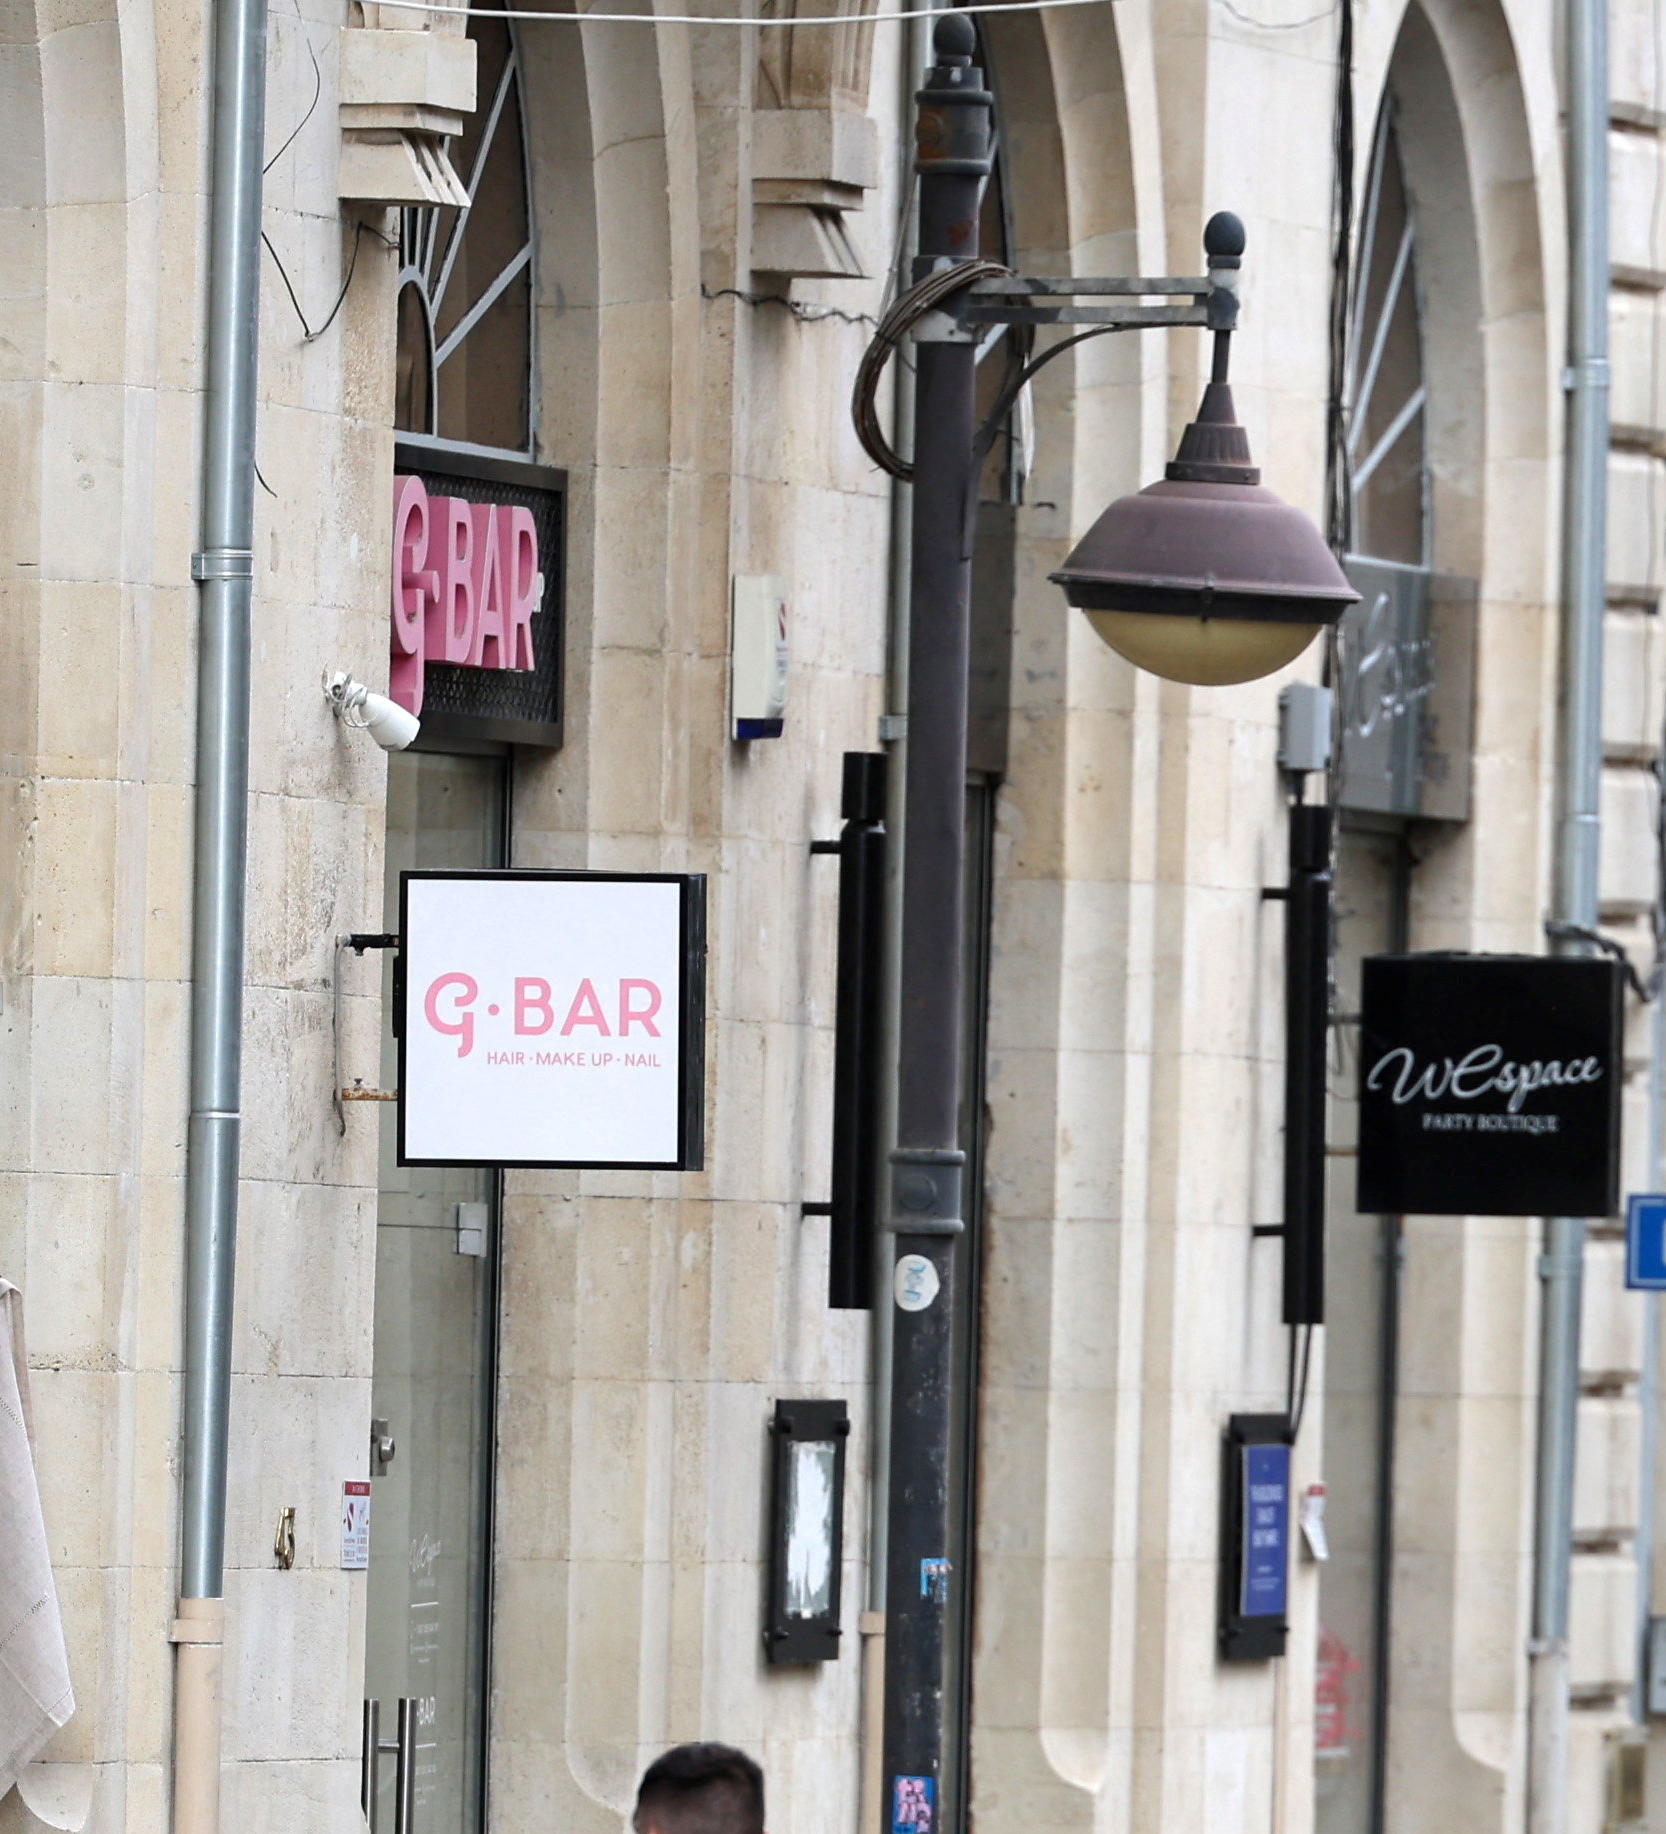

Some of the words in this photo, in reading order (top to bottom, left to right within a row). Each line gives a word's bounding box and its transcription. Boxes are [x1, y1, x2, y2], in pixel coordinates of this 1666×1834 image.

[487, 1052, 525, 1065] HAIR
[536, 1052, 586, 1066] MAKE
[591, 1053, 613, 1066] UP
[624, 1053, 661, 1067] NAIL
[1422, 1113, 1474, 1130] PARTY
[1477, 1114, 1558, 1134] BOUTIQUE
